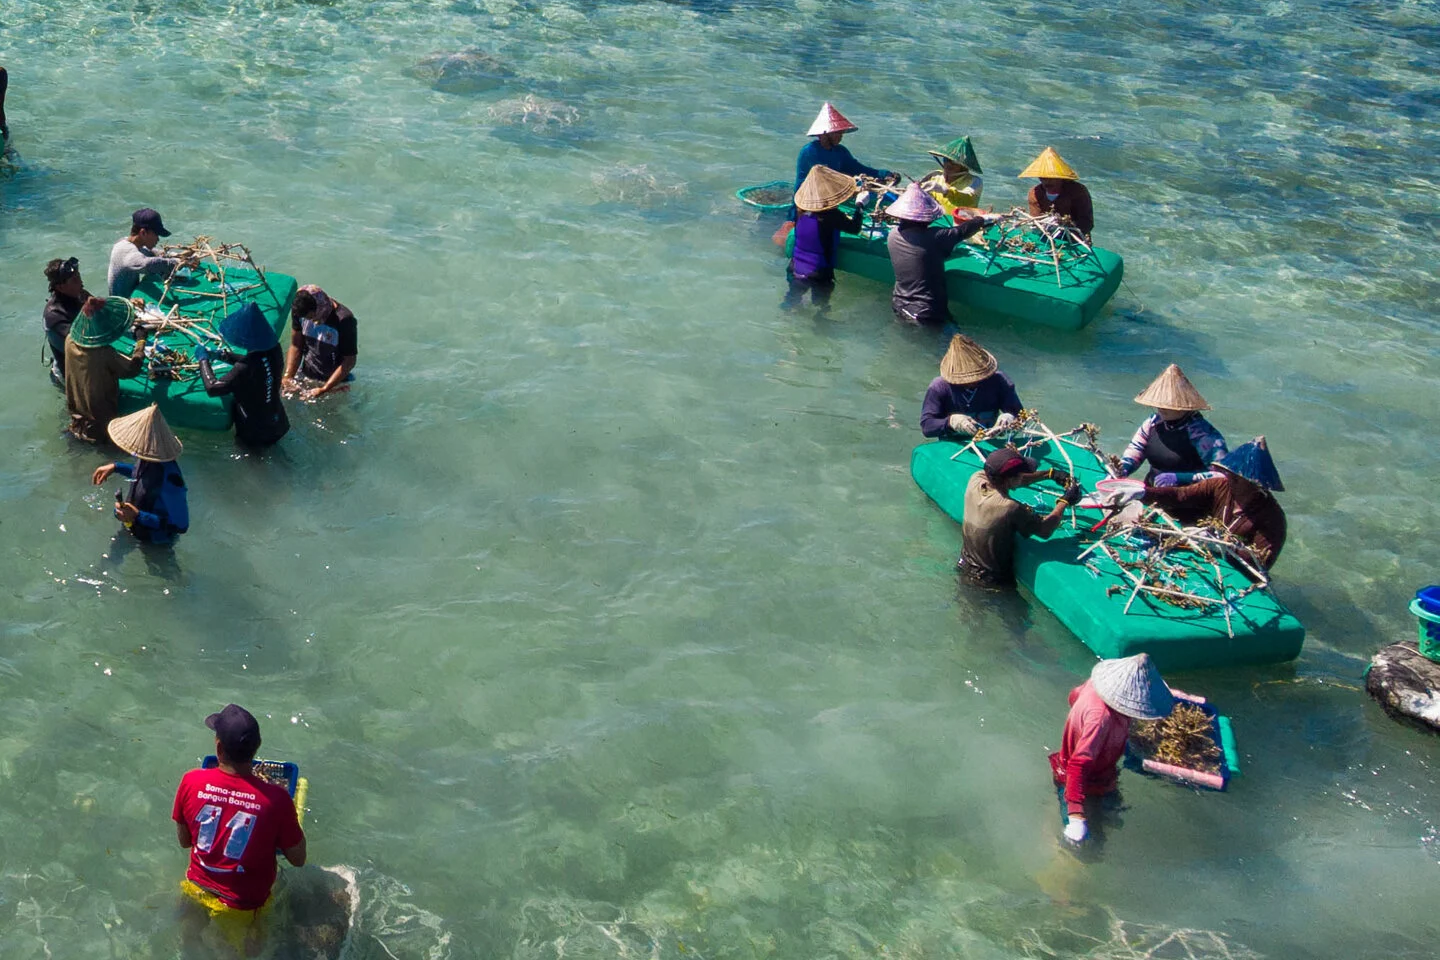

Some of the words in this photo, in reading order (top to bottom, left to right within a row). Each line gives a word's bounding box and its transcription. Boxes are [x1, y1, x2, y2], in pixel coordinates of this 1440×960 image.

[197, 791, 227, 803] Bangun
[228, 797, 261, 810] Bangsa
[205, 783, 256, 800] Sama-sama
[195, 804, 257, 860] 11
